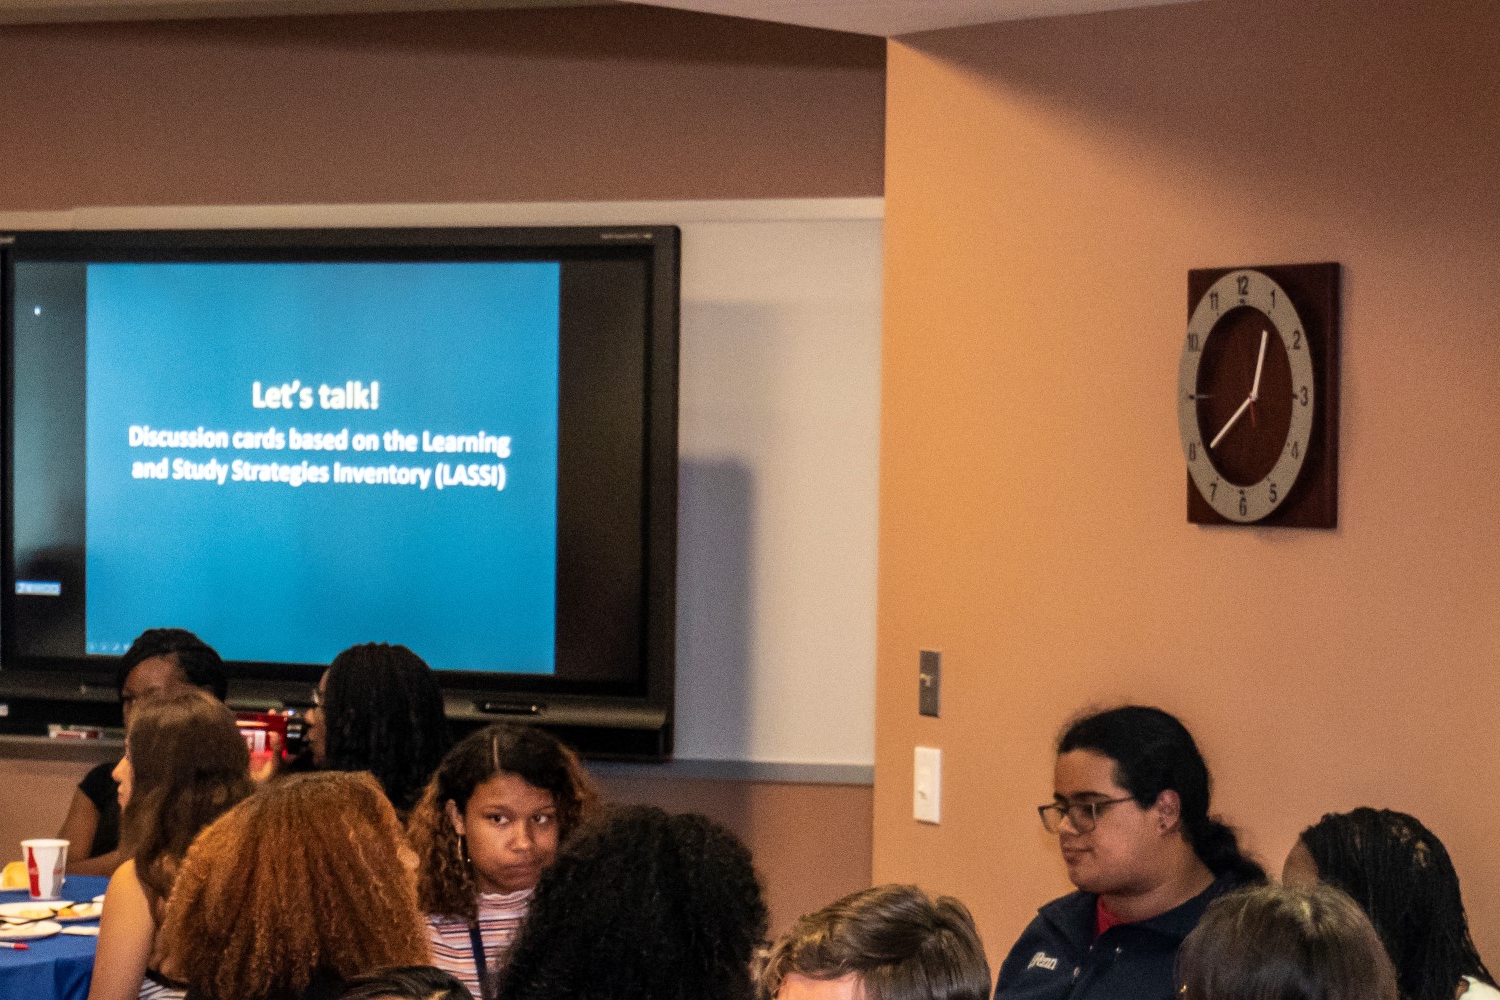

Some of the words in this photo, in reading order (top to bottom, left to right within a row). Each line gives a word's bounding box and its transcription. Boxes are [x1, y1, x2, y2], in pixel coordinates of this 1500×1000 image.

[1237, 276, 1249, 296] 12
[1210, 291, 1219, 310] 11
[1270, 289, 1276, 310] 1
[1187, 333, 1199, 353] 10
[1293, 330, 1301, 350] 2
[252, 380, 314, 410] Let’s
[318, 380, 379, 410] talk!
[1300, 386, 1308, 407] 3
[128, 425, 229, 449] Discussion
[232, 427, 285, 450] cards
[289, 427, 349, 451] based
[352, 433, 380, 452] on
[383, 429, 419, 453] the
[422, 431, 511, 459] Learning
[1291, 441, 1299, 460] 4
[131, 457, 169, 480] and
[172, 457, 229, 486] Study
[231, 459, 330, 488] Strategies
[333, 461, 432, 490] Inventory
[435, 462, 507, 492] (LASSI)
[1210, 482, 1218, 502] 7
[1269, 483, 1277, 503] 5
[1240, 497, 1247, 516] 6
[1027, 951, 1058, 970] Penn
